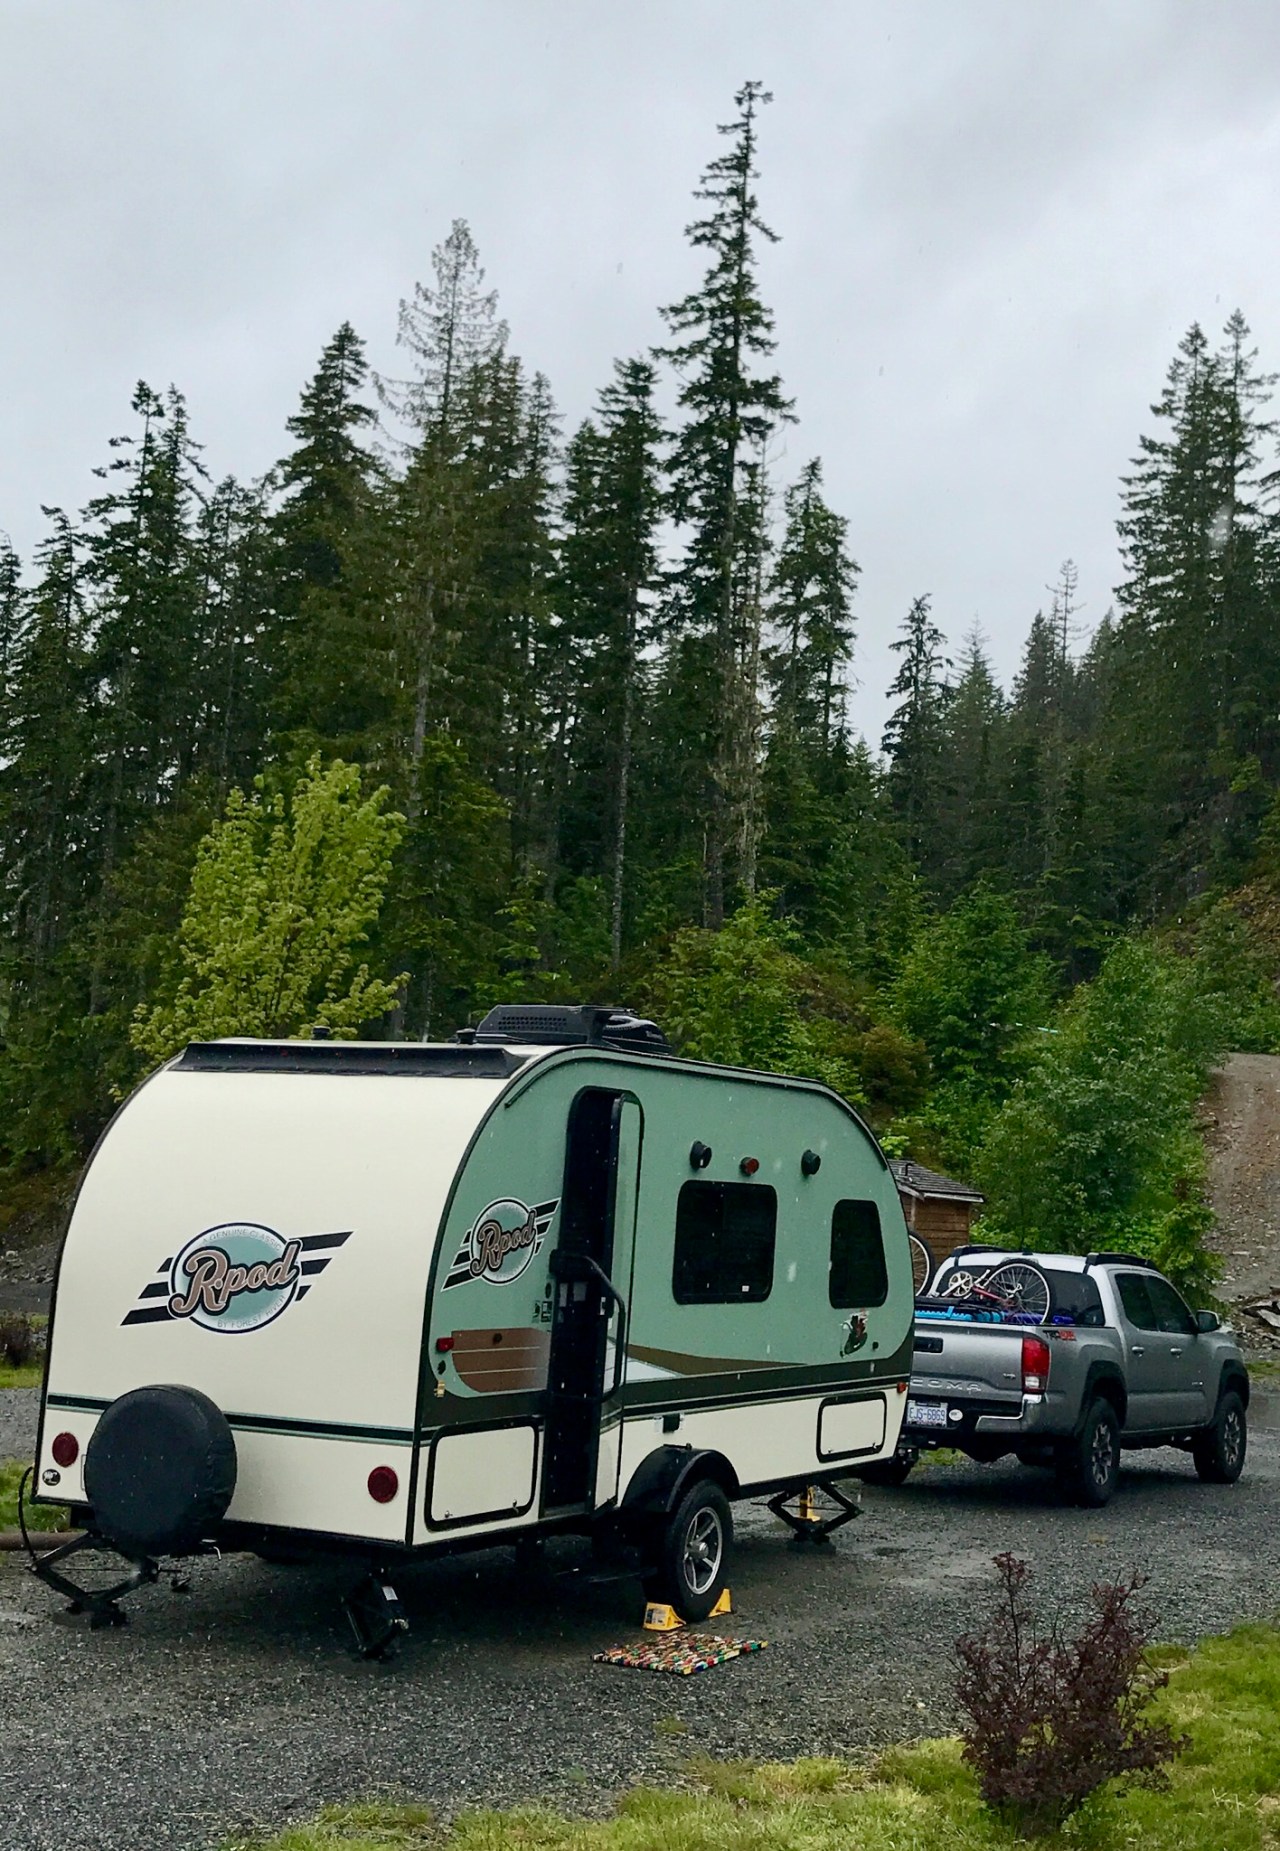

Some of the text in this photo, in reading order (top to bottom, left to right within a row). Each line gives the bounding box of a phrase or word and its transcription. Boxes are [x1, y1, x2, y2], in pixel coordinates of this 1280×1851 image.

[209, 1228, 249, 1241] GENUINE
[249, 1230, 282, 1251] CLASSIC
[217, 1319, 227, 1328] BY
[231, 1314, 262, 1329] FOREST
